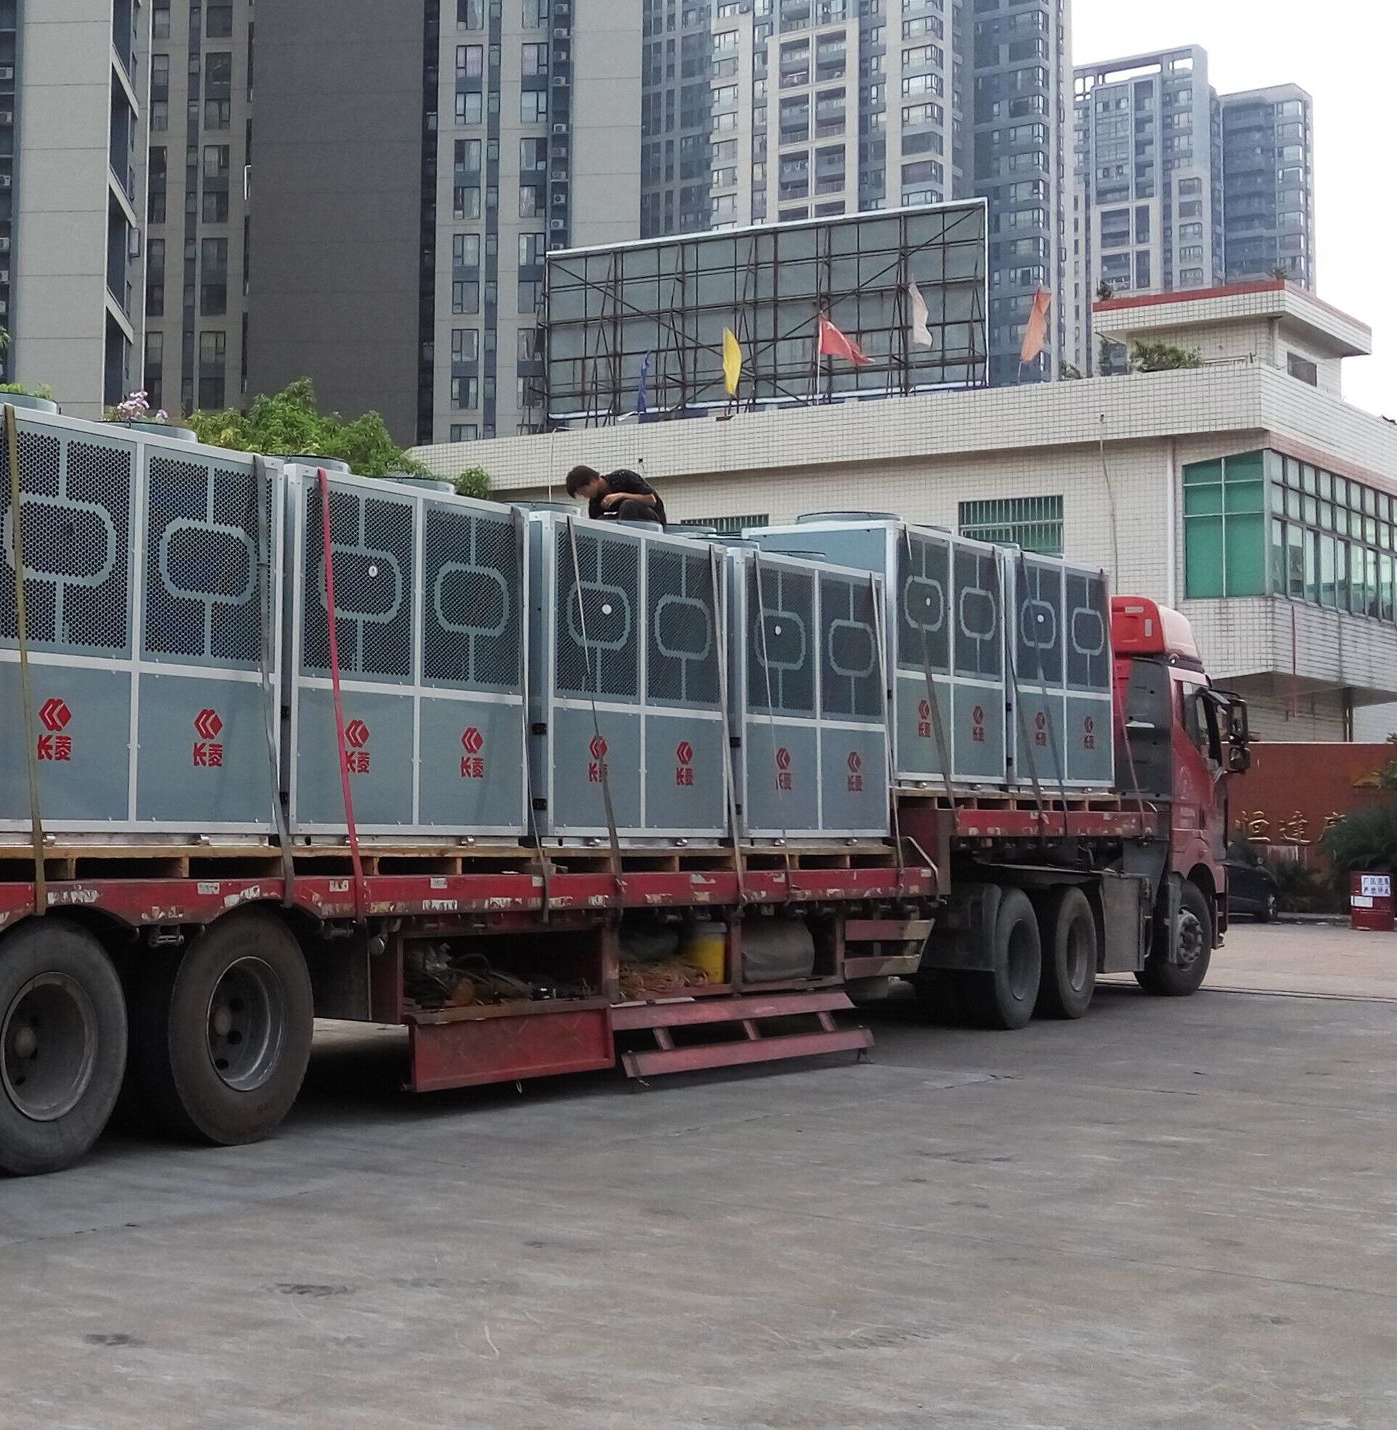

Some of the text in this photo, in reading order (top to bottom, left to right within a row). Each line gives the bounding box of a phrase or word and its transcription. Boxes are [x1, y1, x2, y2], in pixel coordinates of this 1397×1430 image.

[37, 734, 71, 760] 长菱
[193, 742, 222, 767] 长菱
[345, 750, 369, 773] 长菱
[460, 756, 483, 778] 长菱
[676, 767, 693, 786] 长菱
